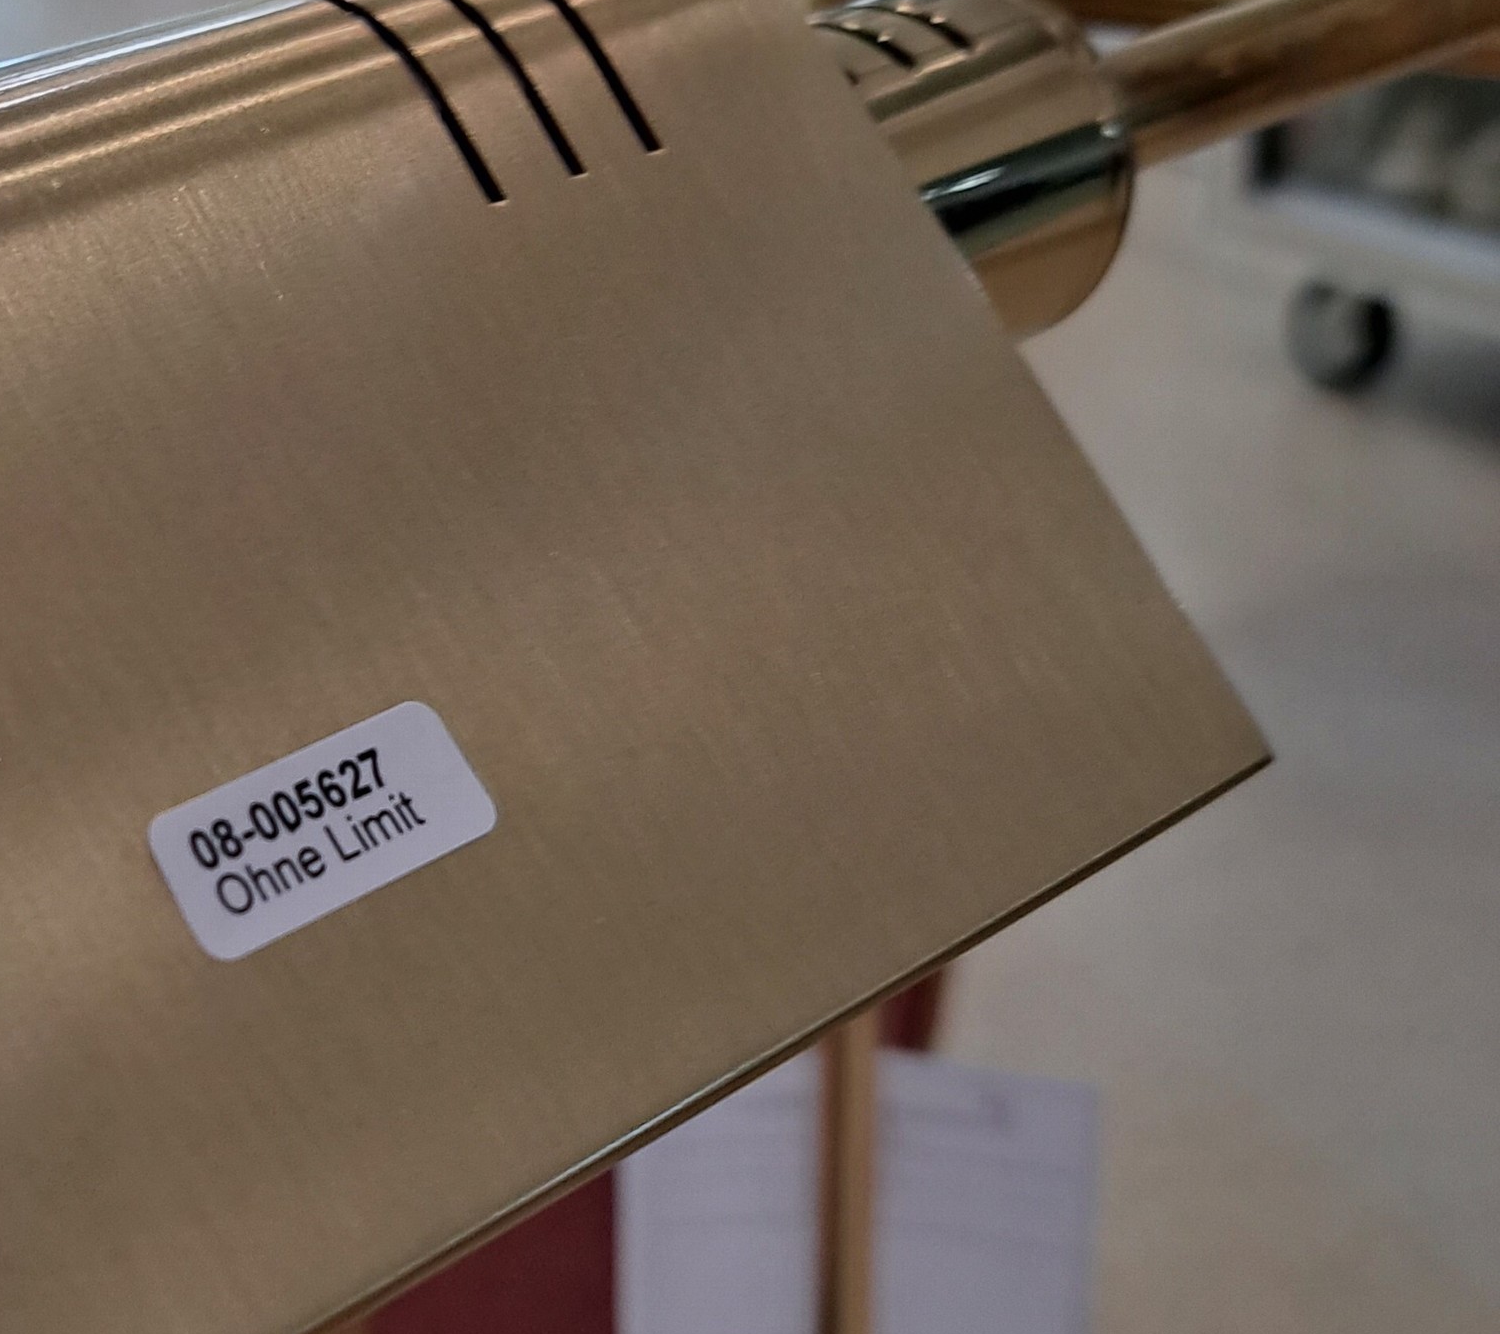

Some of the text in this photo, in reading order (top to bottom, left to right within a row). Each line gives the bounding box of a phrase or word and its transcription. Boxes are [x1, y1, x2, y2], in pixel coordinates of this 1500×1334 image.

[188, 747, 386, 869] 08-005627
[215, 791, 427, 915] Ohne Limit
